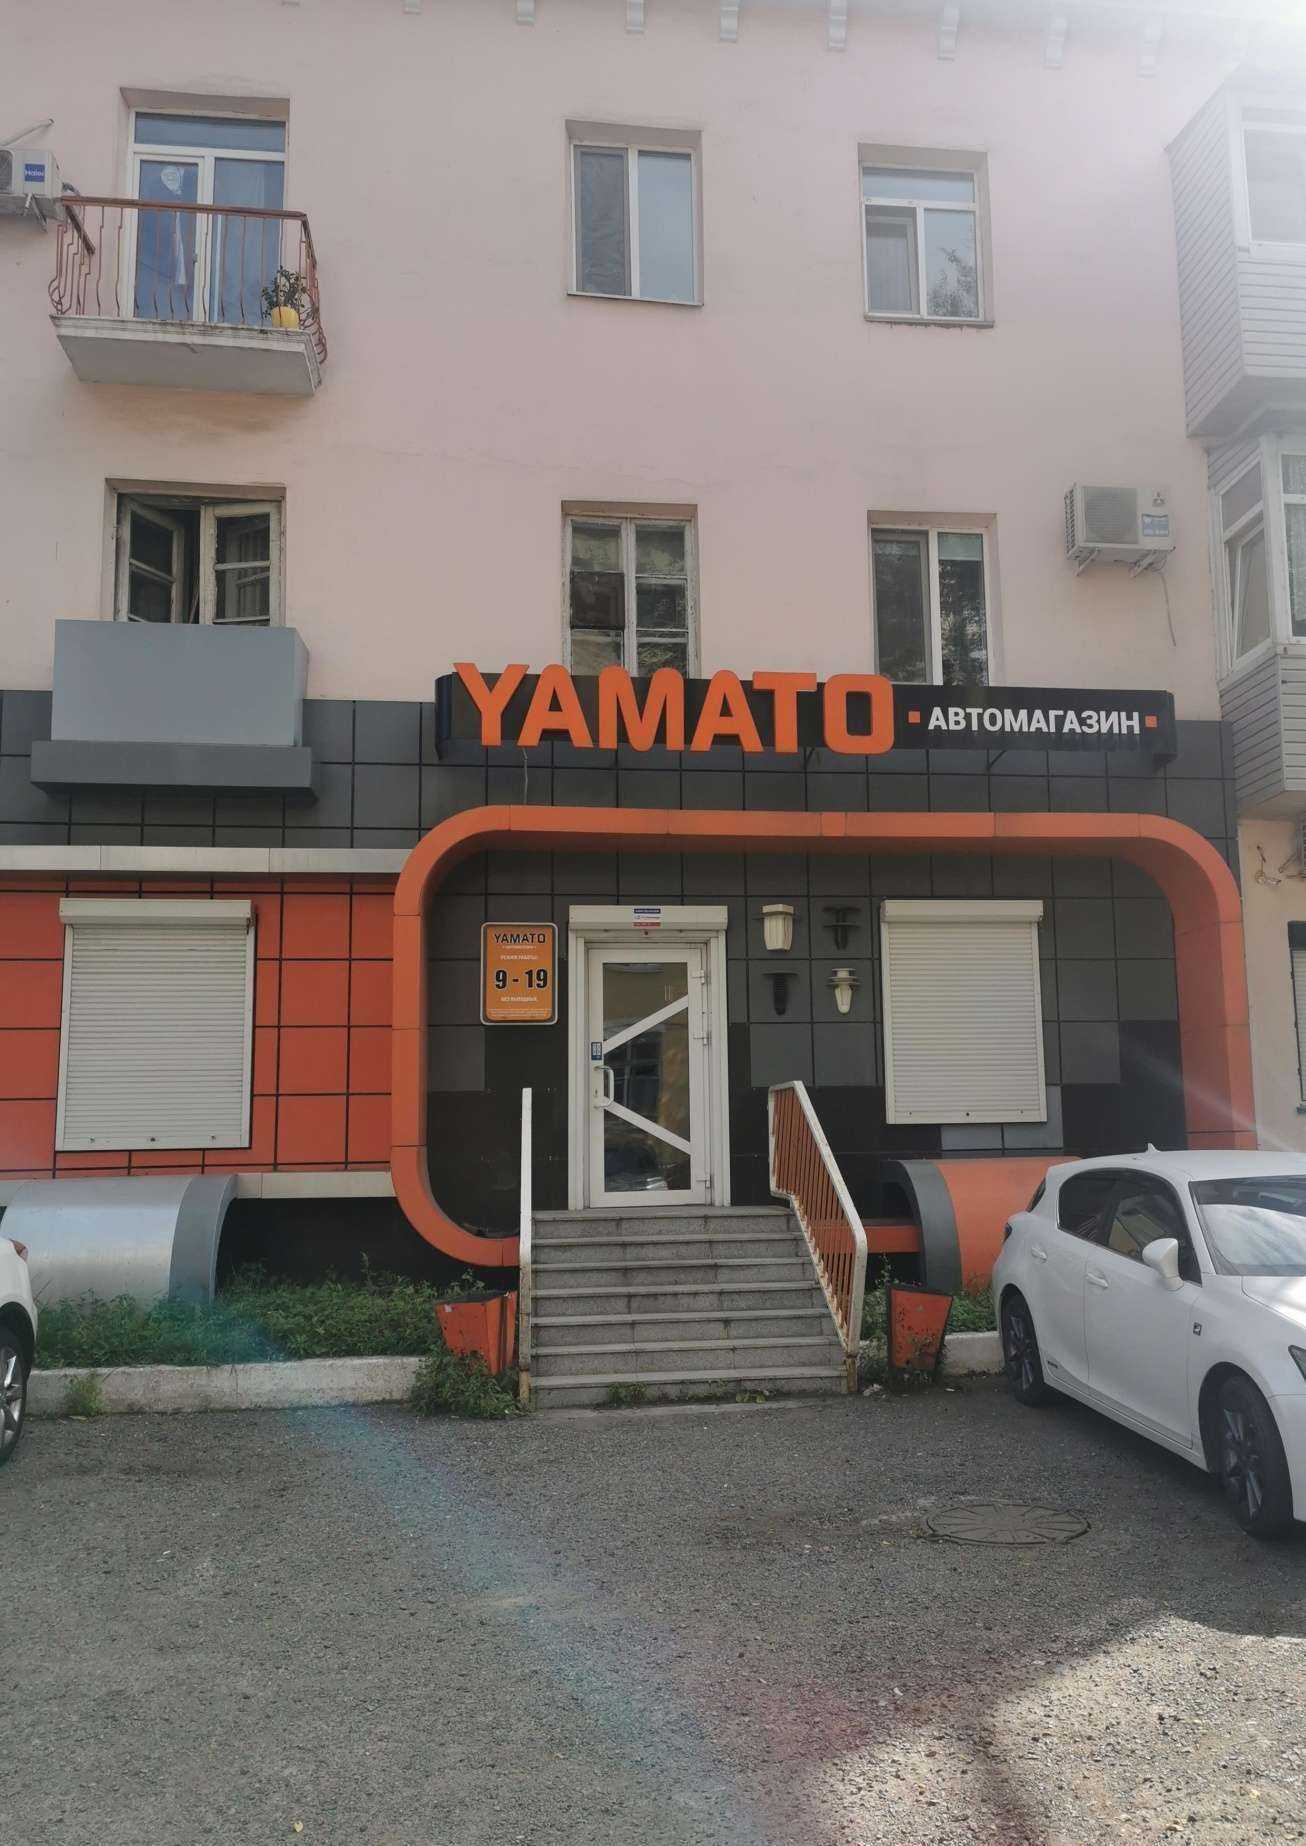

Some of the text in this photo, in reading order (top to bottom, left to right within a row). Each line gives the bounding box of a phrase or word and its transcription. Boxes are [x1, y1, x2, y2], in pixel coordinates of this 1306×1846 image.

[453, 663, 895, 755] YAMATO
[928, 707, 1140, 734] АВТОМАГАЗИН
[494, 933, 546, 943] YAMATO
[495, 969, 507, 989] 9
[525, 969, 548, 988] 19
